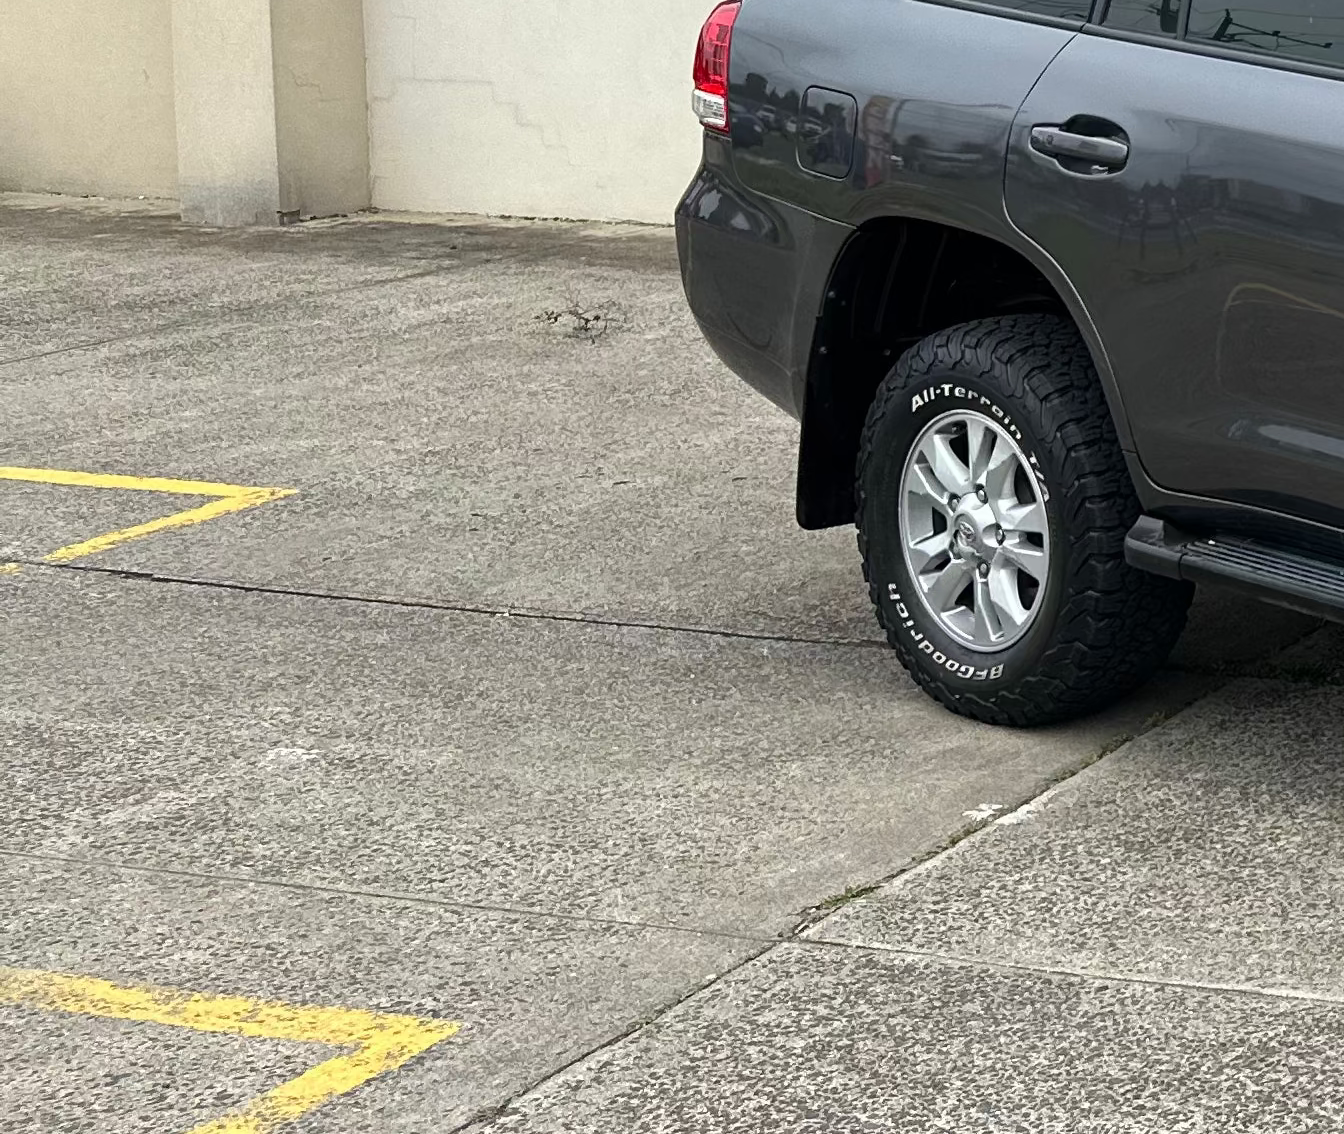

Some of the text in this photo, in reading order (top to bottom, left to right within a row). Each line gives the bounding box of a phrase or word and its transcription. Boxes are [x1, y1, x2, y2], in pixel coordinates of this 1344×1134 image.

[910, 382, 1050, 503] All-Terrain T/A
[887, 582, 1005, 681] BFGoodrich
